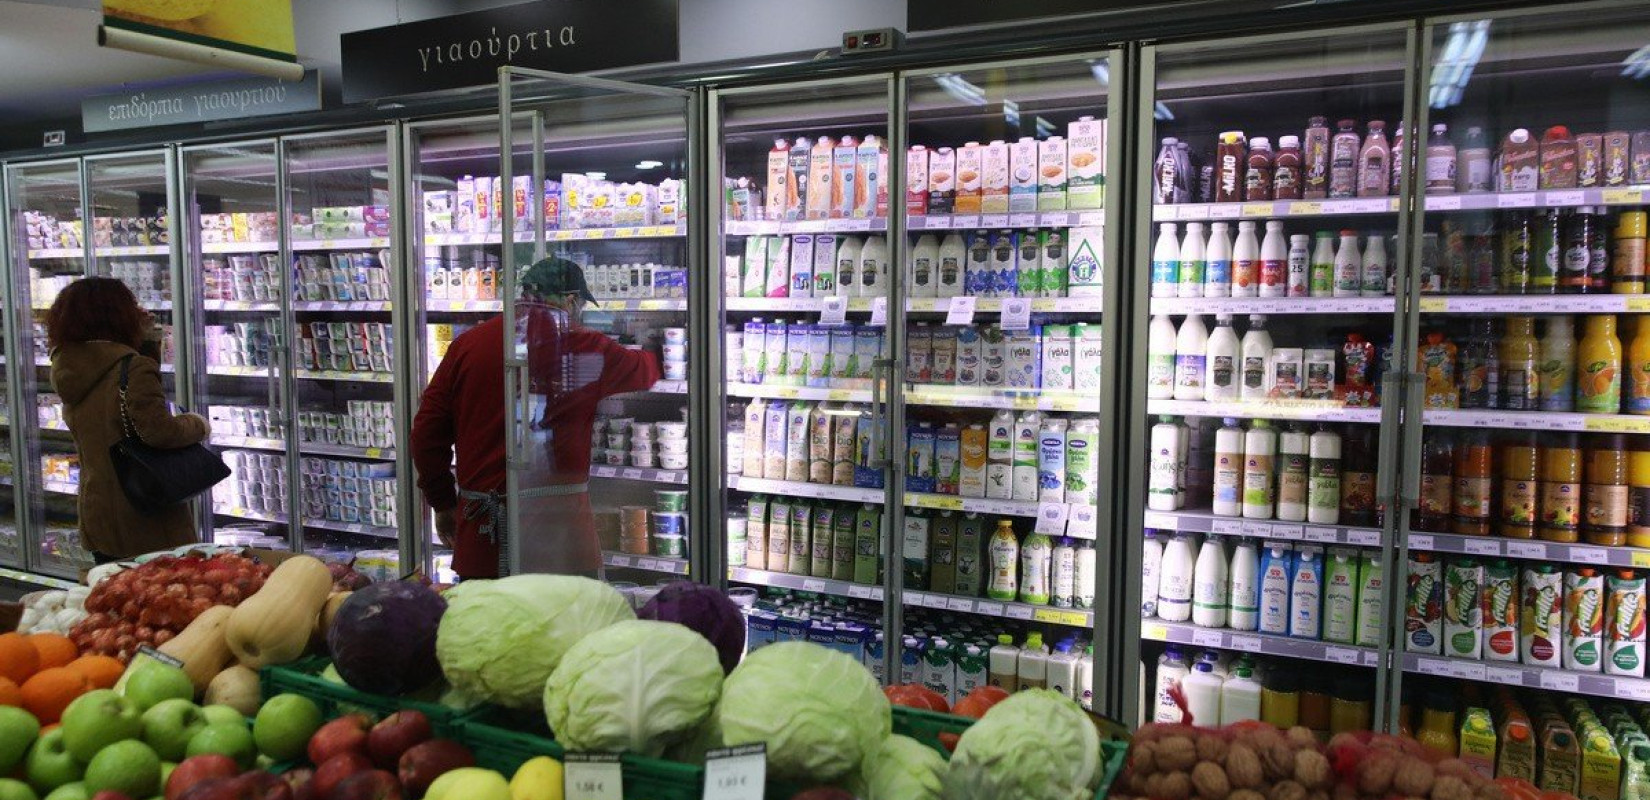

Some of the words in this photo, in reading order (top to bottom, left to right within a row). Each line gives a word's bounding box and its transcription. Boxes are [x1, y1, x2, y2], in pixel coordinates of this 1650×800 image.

[418, 25, 576, 72] γιαούρτια
[108, 93, 183, 122] επιδόρπια
[193, 77, 286, 116] γιαουρτιού
